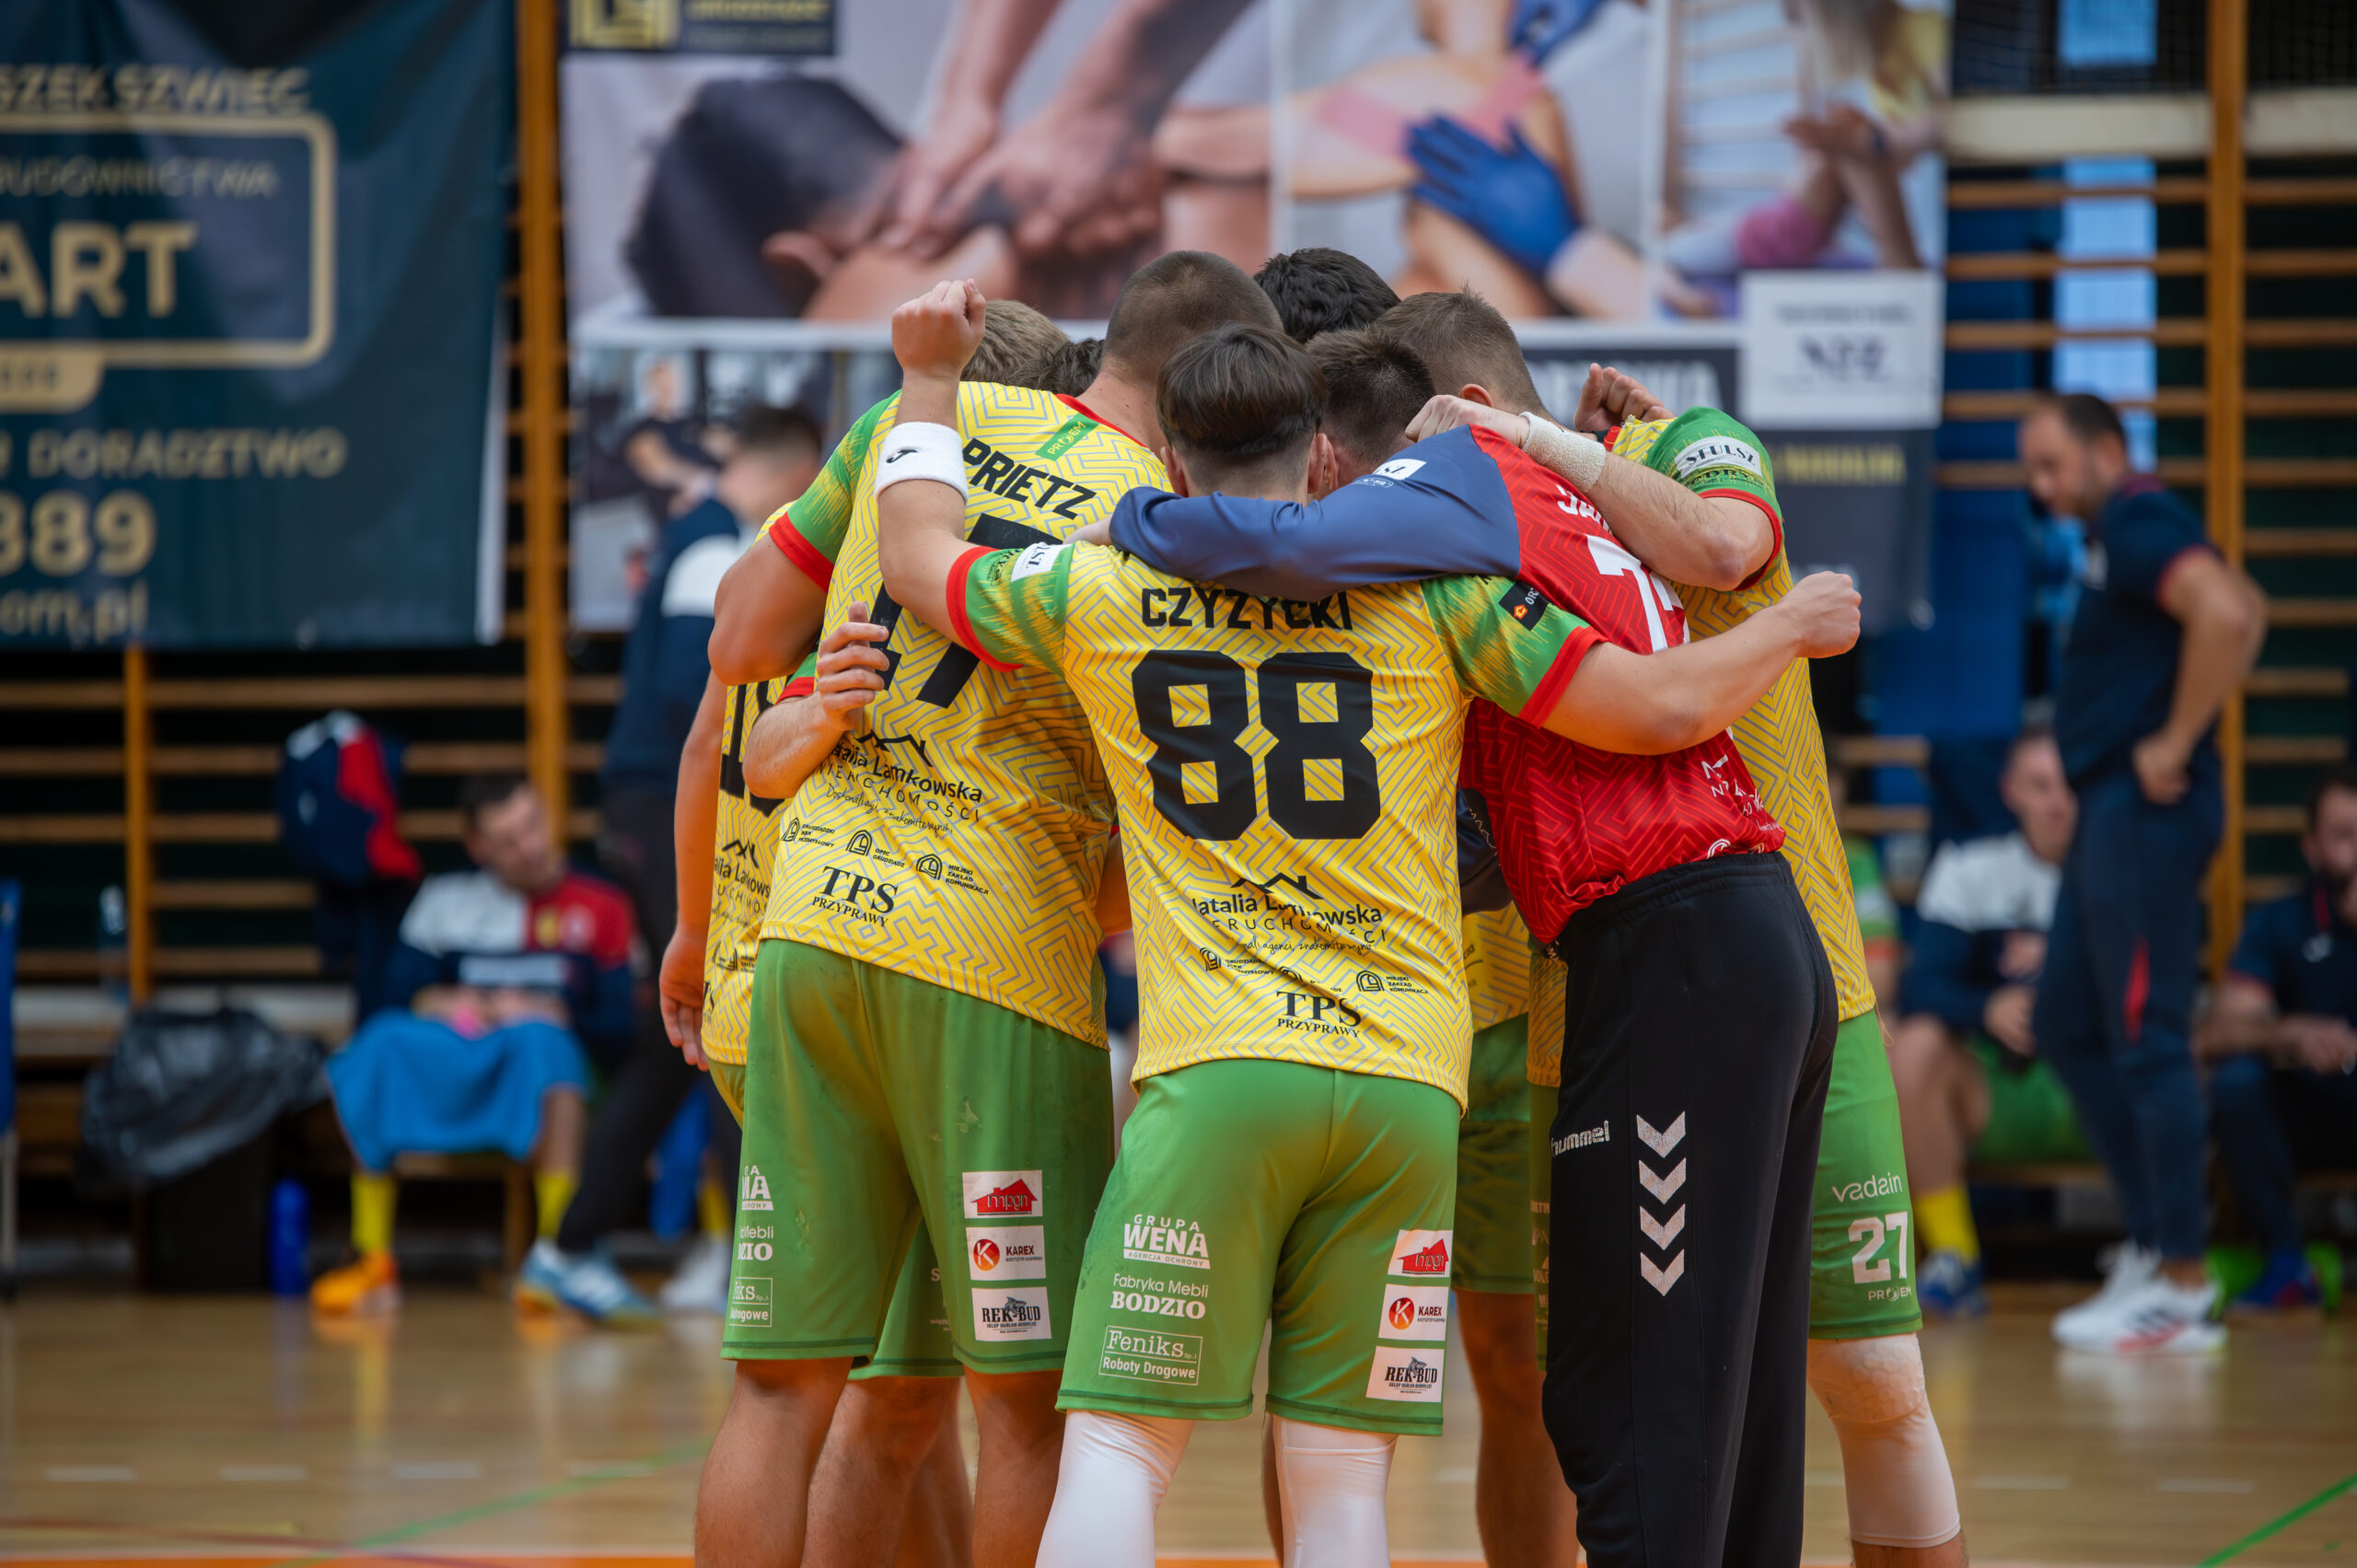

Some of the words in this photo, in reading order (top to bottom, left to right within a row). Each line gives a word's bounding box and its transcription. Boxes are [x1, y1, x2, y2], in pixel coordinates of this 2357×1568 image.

[0, 222, 197, 317] ART
[1047, 421, 1086, 455] PROEM
[27, 428, 348, 479] DORADZTWO
[962, 437, 1097, 520] PRIETZ
[1525, 587, 1541, 607] OR
[1132, 649, 1381, 842] 88
[819, 865, 899, 914] TPS
[812, 896, 889, 928] PRZYPRAWY
[1276, 991, 1362, 1028] TPS
[1277, 1017, 1361, 1039] PRZYPRAWY
[1551, 1120, 1610, 1156] hummel
[1832, 1172, 1903, 1202] vadain
[987, 1193, 1029, 1211] mpgn
[1133, 1214, 1200, 1232] GRUPA
[1005, 1245, 1035, 1256] KAREX
[1123, 1224, 1208, 1258] WENA
[1848, 1211, 1908, 1284] 27
[1128, 1251, 1161, 1262] AGENCJA
[1165, 1256, 1204, 1267] OCHRONY
[1113, 1273, 1164, 1293] Fabryka
[1167, 1280, 1208, 1298] Mebli
[981, 1306, 1040, 1322] REK-BUD
[1110, 1291, 1206, 1318] BODZIO
[1418, 1306, 1443, 1317] KAREX
[1107, 1330, 1184, 1358] Feniks
[1103, 1357, 1141, 1375] Roboty
[1143, 1361, 1196, 1379] Drogowe
[1384, 1366, 1438, 1383] REK-BUD
